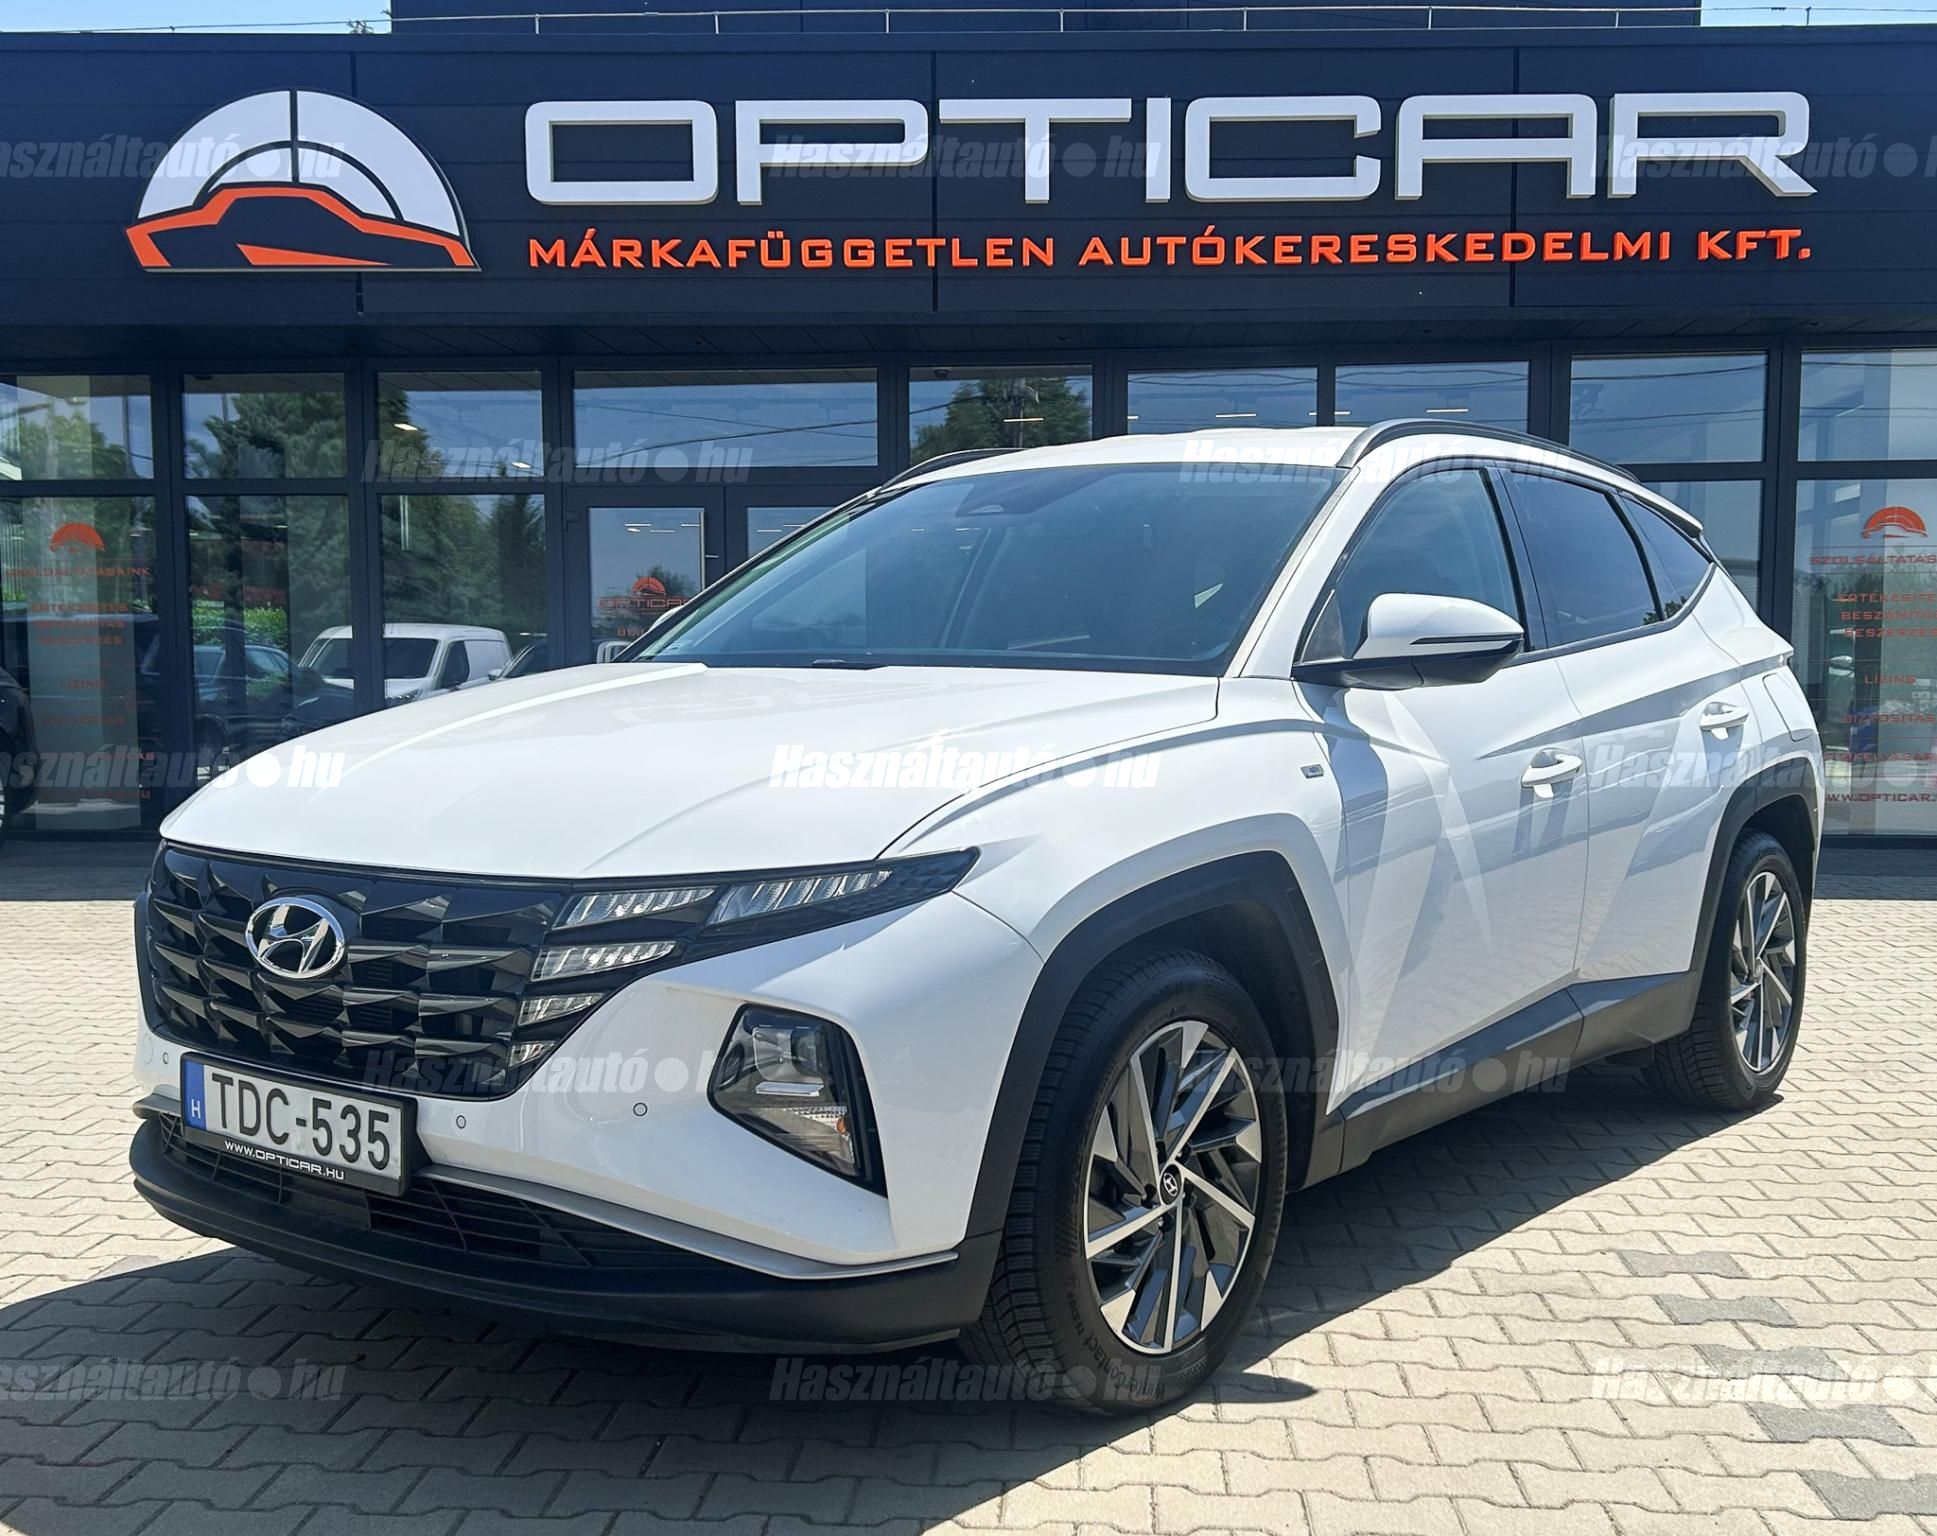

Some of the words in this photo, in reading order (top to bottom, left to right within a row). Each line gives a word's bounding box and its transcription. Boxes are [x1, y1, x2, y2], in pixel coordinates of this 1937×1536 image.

[525, 92, 1817, 206] OPTICAR
[528, 228, 1055, 268] MÁRKAFÜGGETLEN
[1078, 225, 1672, 268] AUTÓKERESKEDELMI
[1698, 229, 1813, 262] KFT.
[191, 1099, 201, 1119] H
[211, 1073, 390, 1170] TDC-535
[224, 1140, 345, 1181] WWW.OPTICAR.HU
